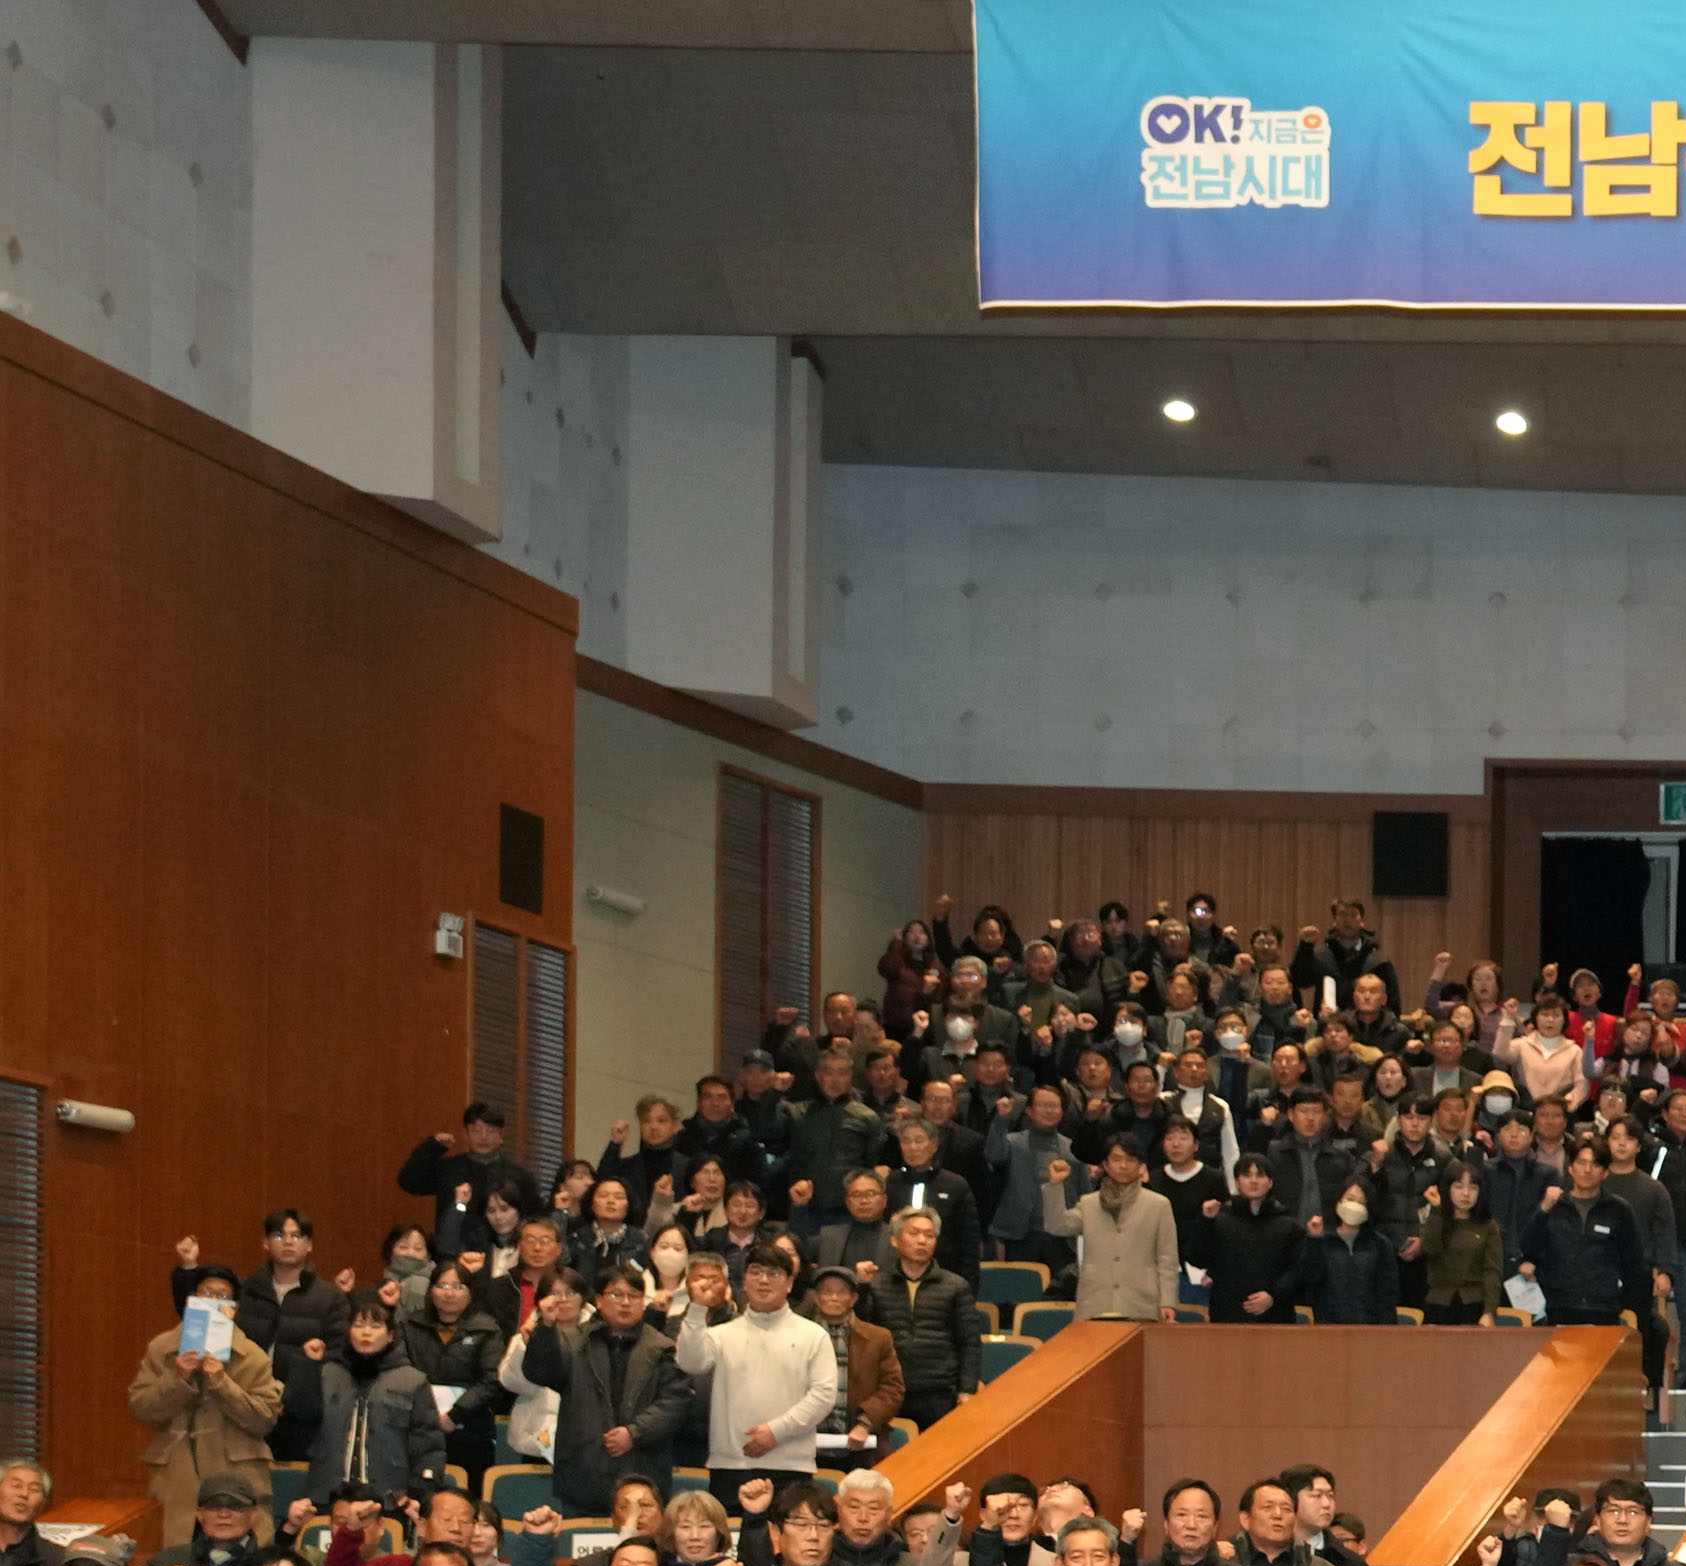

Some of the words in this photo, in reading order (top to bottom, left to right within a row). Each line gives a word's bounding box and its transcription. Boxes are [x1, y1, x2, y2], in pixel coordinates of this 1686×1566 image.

[1148, 103, 1244, 144] OK!
[1249, 114, 1324, 144] 지금은
[1148, 154, 1323, 200] 전남시대
